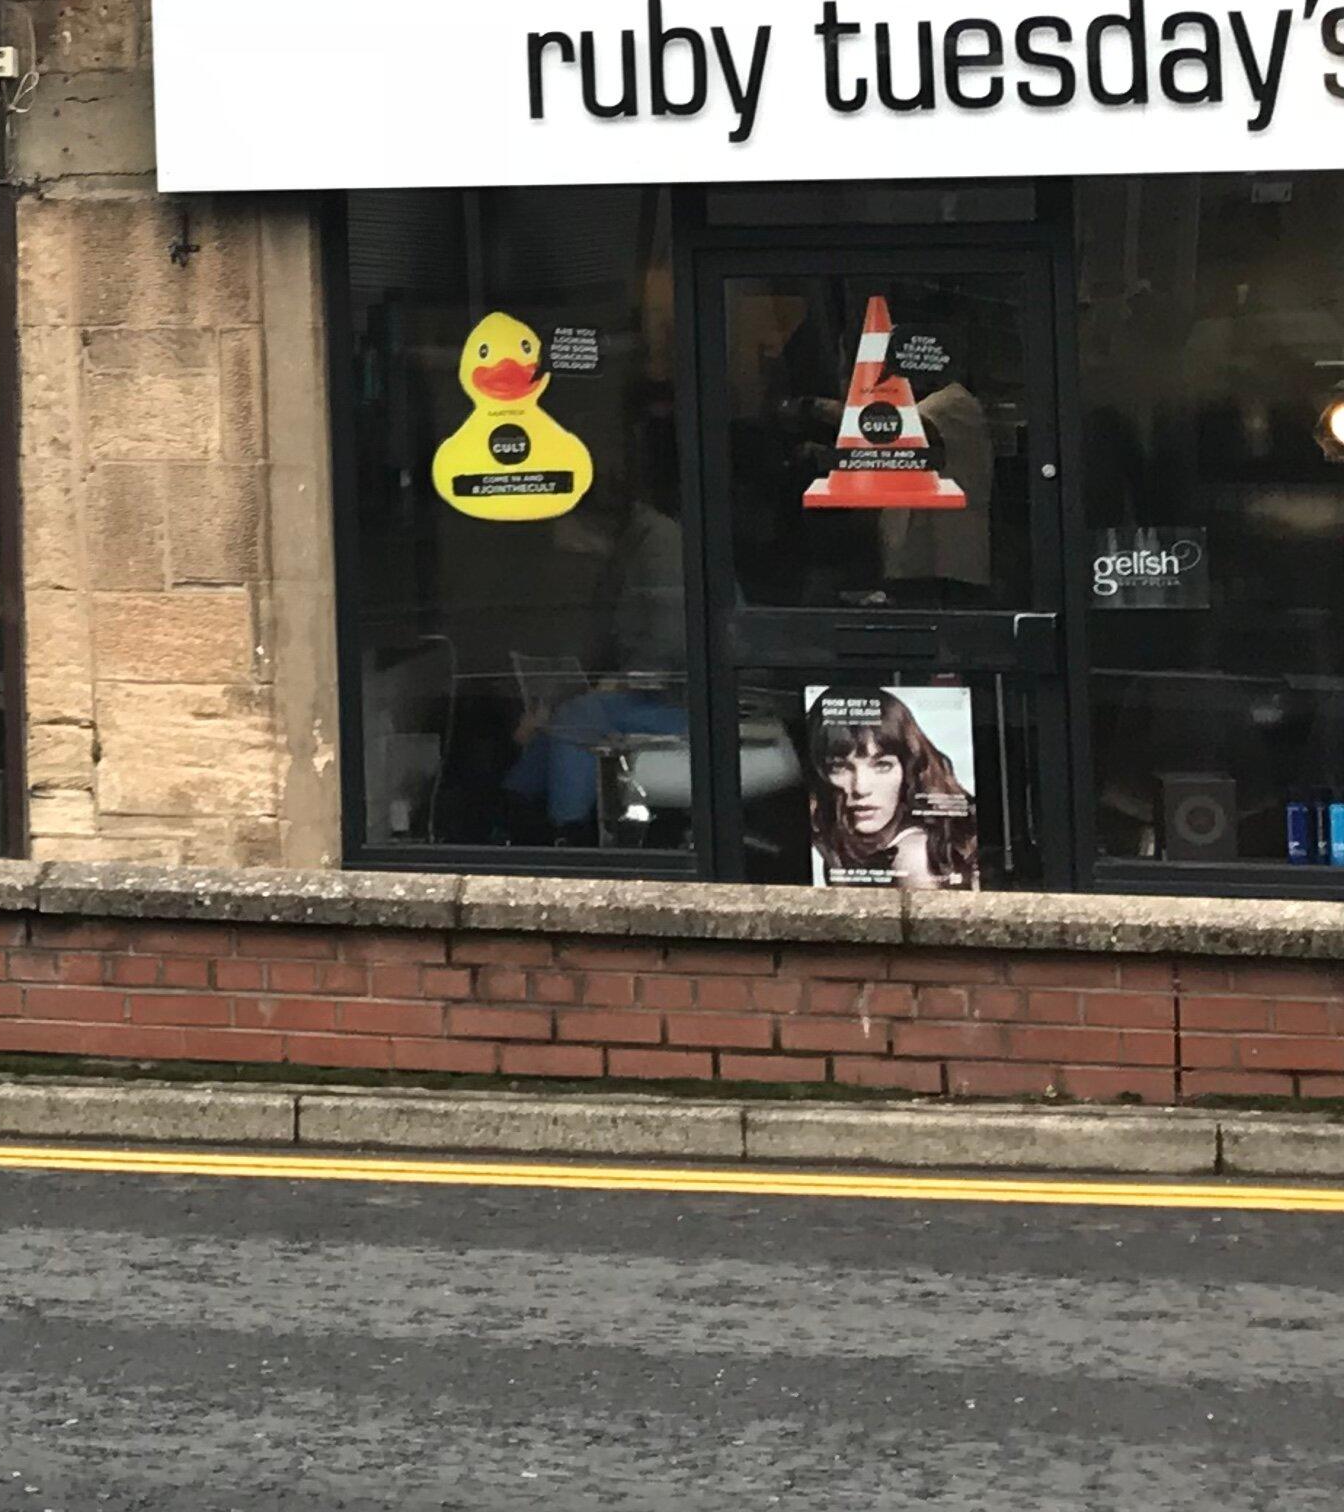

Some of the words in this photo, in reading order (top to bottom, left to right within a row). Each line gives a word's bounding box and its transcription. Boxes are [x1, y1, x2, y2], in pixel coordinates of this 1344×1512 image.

[863, 421, 898, 432] CULT
[492, 442, 526, 454] CULT
[1093, 549, 1180, 596] gelish
